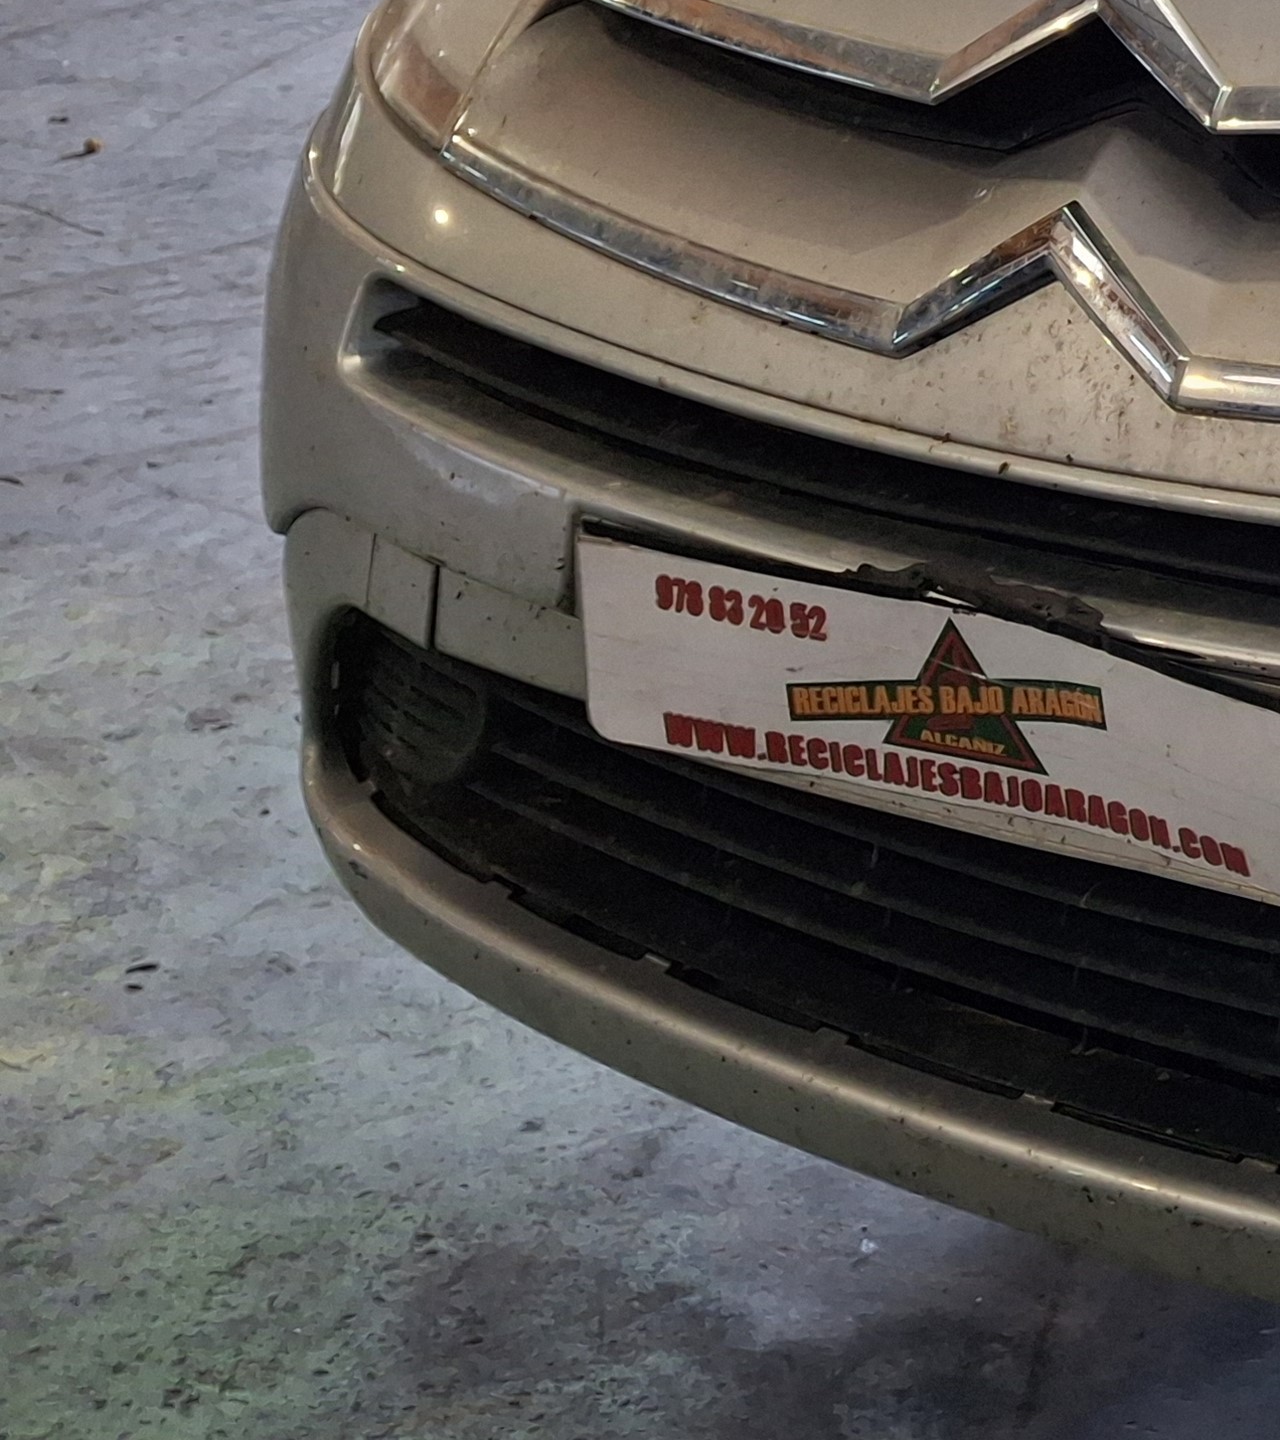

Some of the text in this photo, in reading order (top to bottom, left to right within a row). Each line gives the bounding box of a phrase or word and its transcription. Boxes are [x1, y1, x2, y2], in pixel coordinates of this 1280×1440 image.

[655, 573, 705, 617] 978
[708, 585, 745, 626] 83
[789, 601, 828, 642] 52
[791, 684, 934, 717] RECICLAJES
[938, 685, 1006, 717] BAJO
